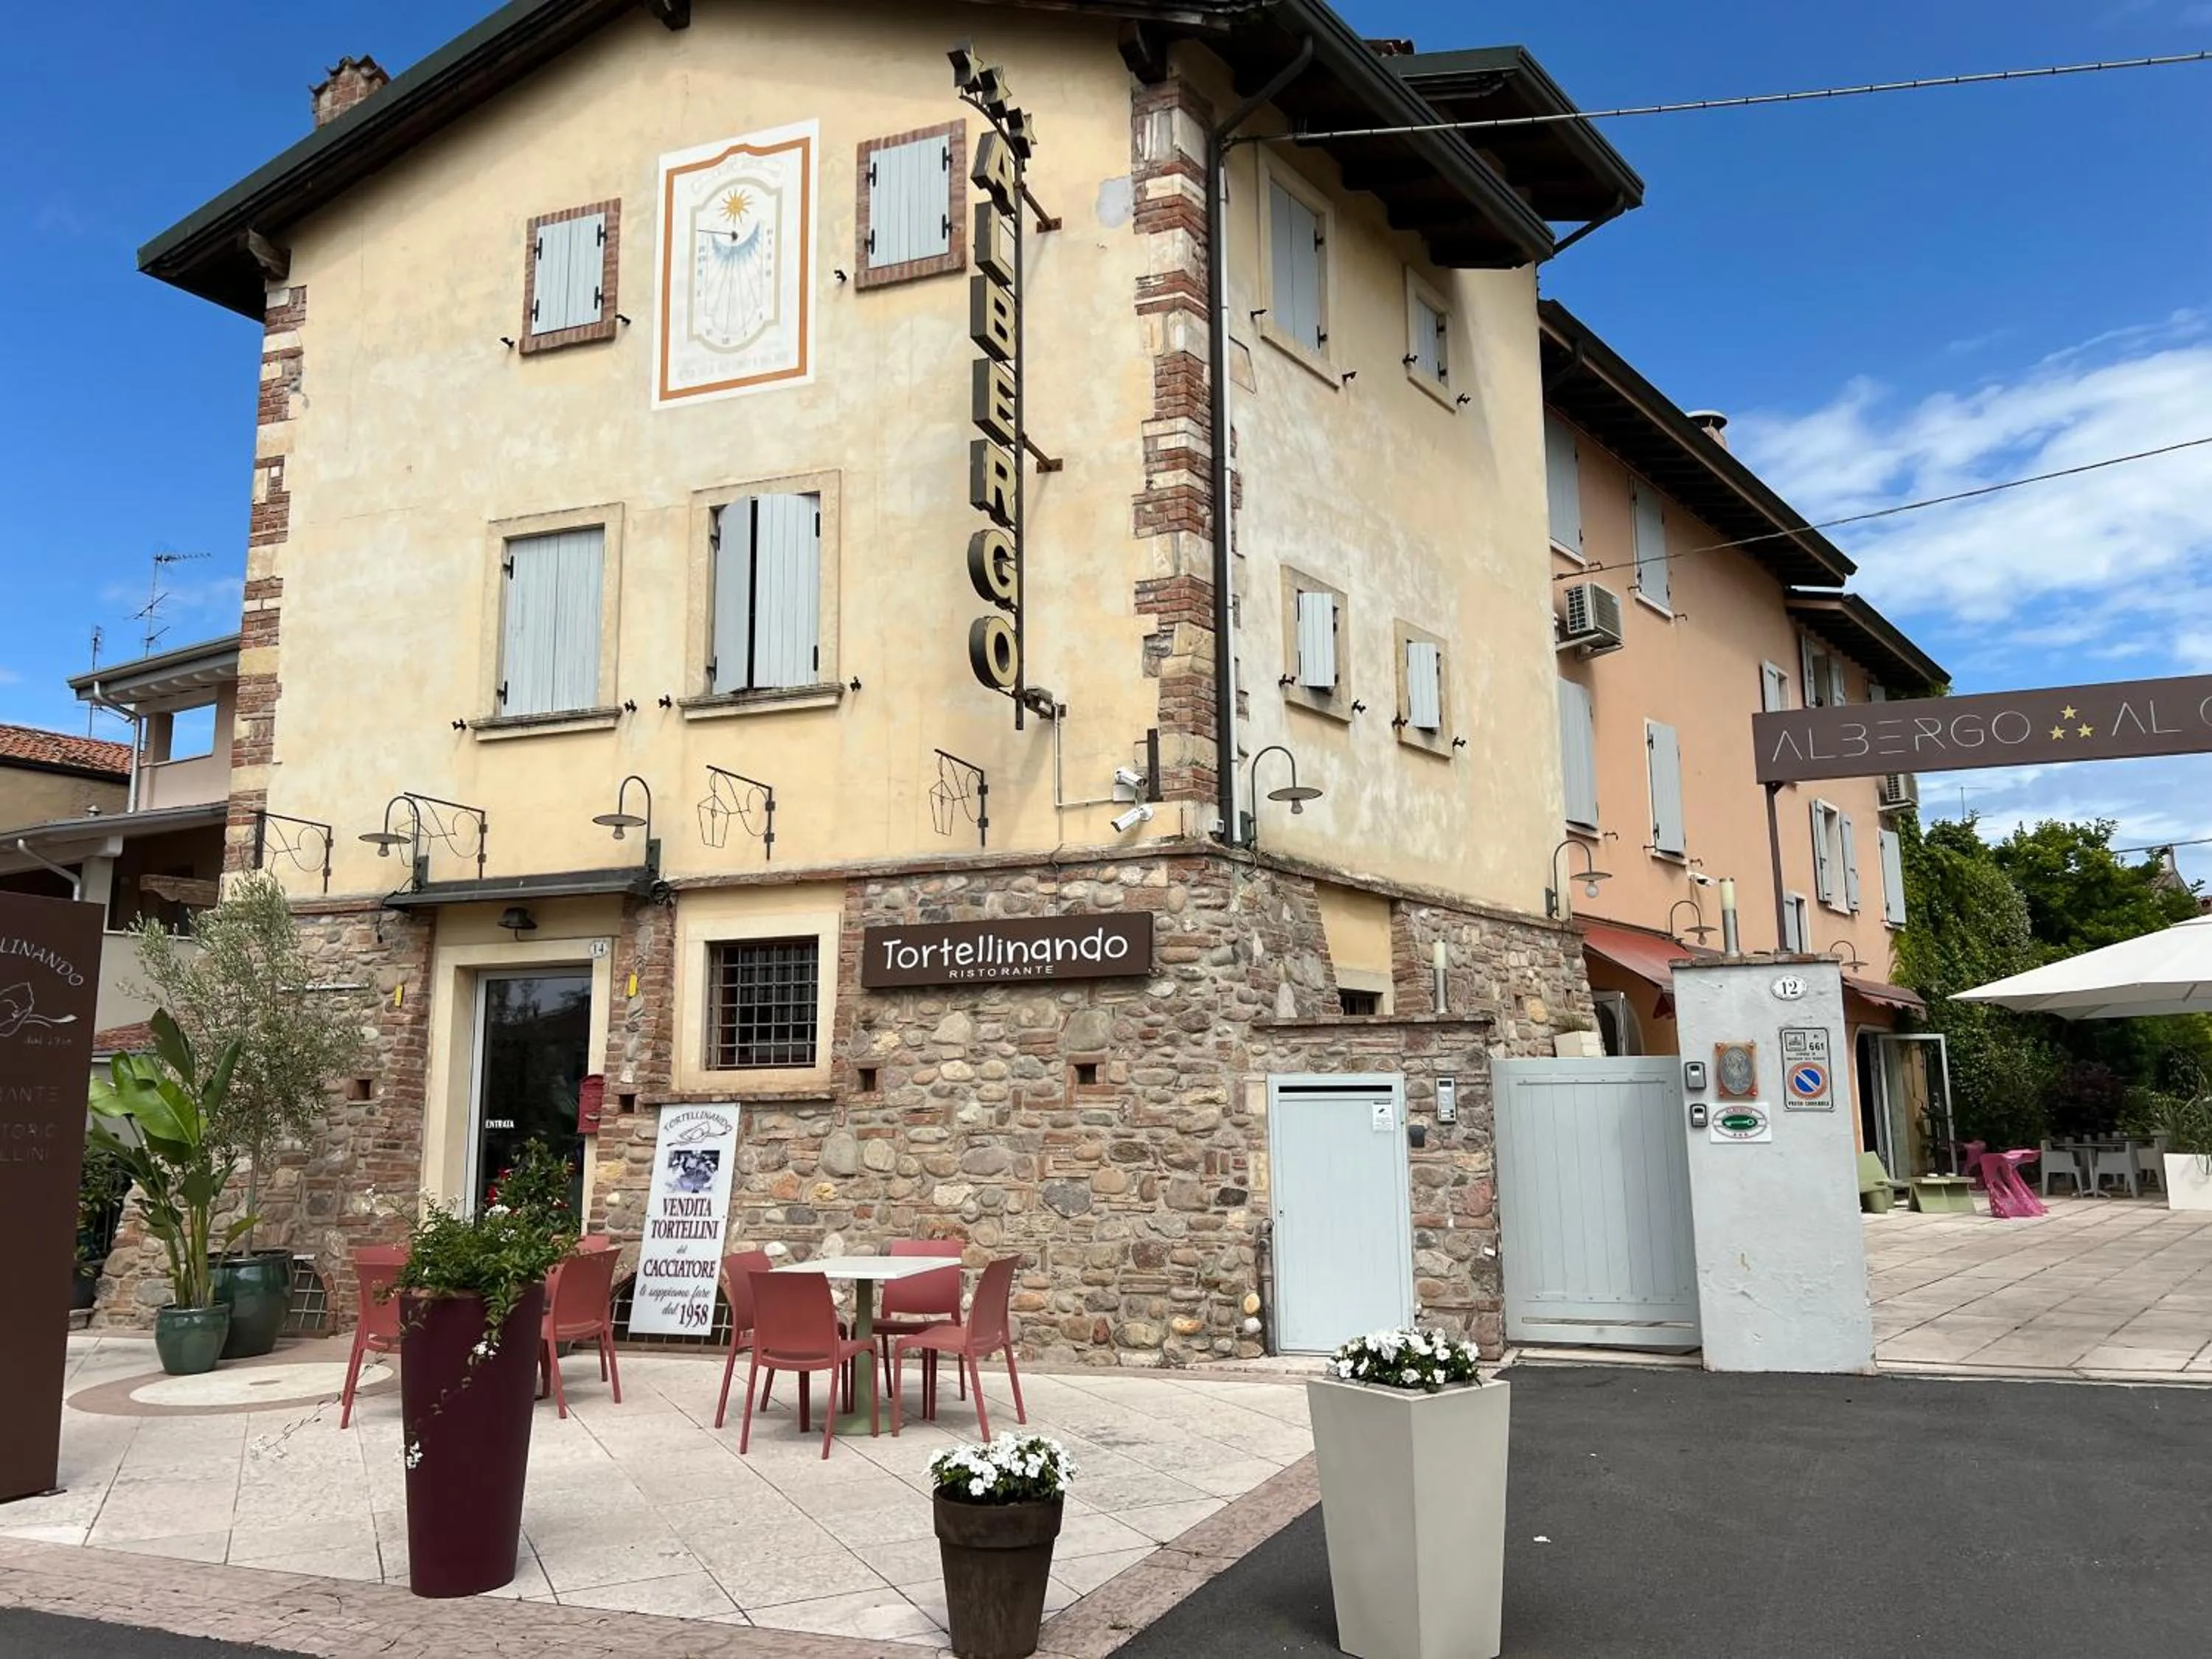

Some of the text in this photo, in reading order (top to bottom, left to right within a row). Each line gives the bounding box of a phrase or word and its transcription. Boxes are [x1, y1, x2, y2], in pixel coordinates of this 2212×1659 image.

[969, 130, 1018, 691] ALBERGO
[1772, 711, 2031, 762] ALBERGO
[2112, 700, 2183, 737] AL
[592, 944, 605, 955] 14
[883, 928, 1129, 970] Tortellinando
[948, 965, 1054, 979] RISTORANTE
[1781, 981, 1798, 995] 12
[1809, 1042, 1825, 1051] 661
[484, 1119, 515, 1130] ENTRATA
[663, 1198, 712, 1217] VENDITA
[651, 1220, 720, 1239] TORTELLINI
[643, 1258, 717, 1278] CACCIATORE
[679, 1304, 709, 1328] 1958
